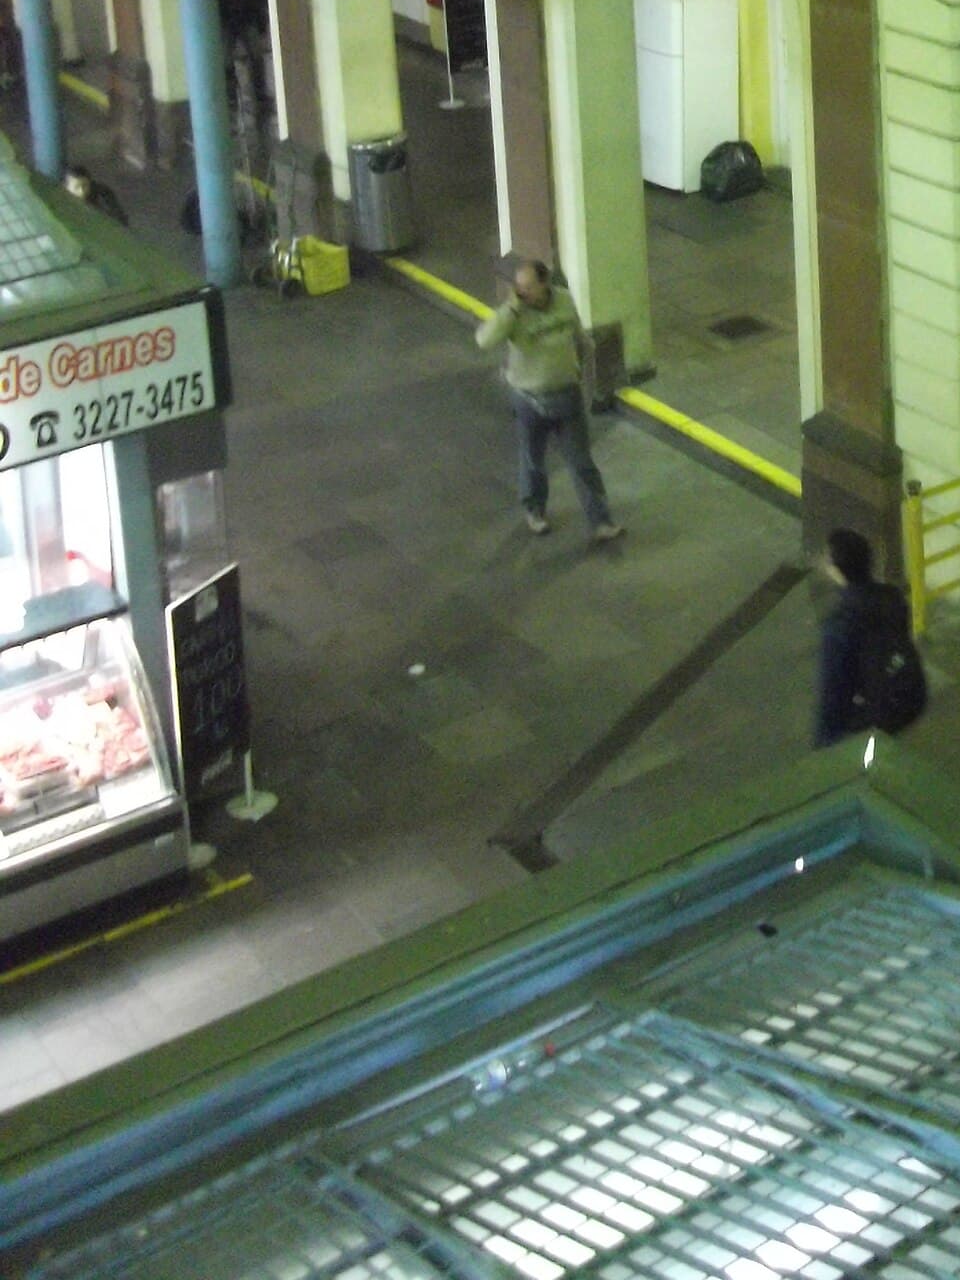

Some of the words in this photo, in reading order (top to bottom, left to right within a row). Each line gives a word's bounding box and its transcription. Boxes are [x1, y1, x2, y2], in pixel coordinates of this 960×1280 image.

[0, 356, 41, 403] de
[48, 326, 175, 388] Carnes
[73, 371, 204, 440] 3227-3475
